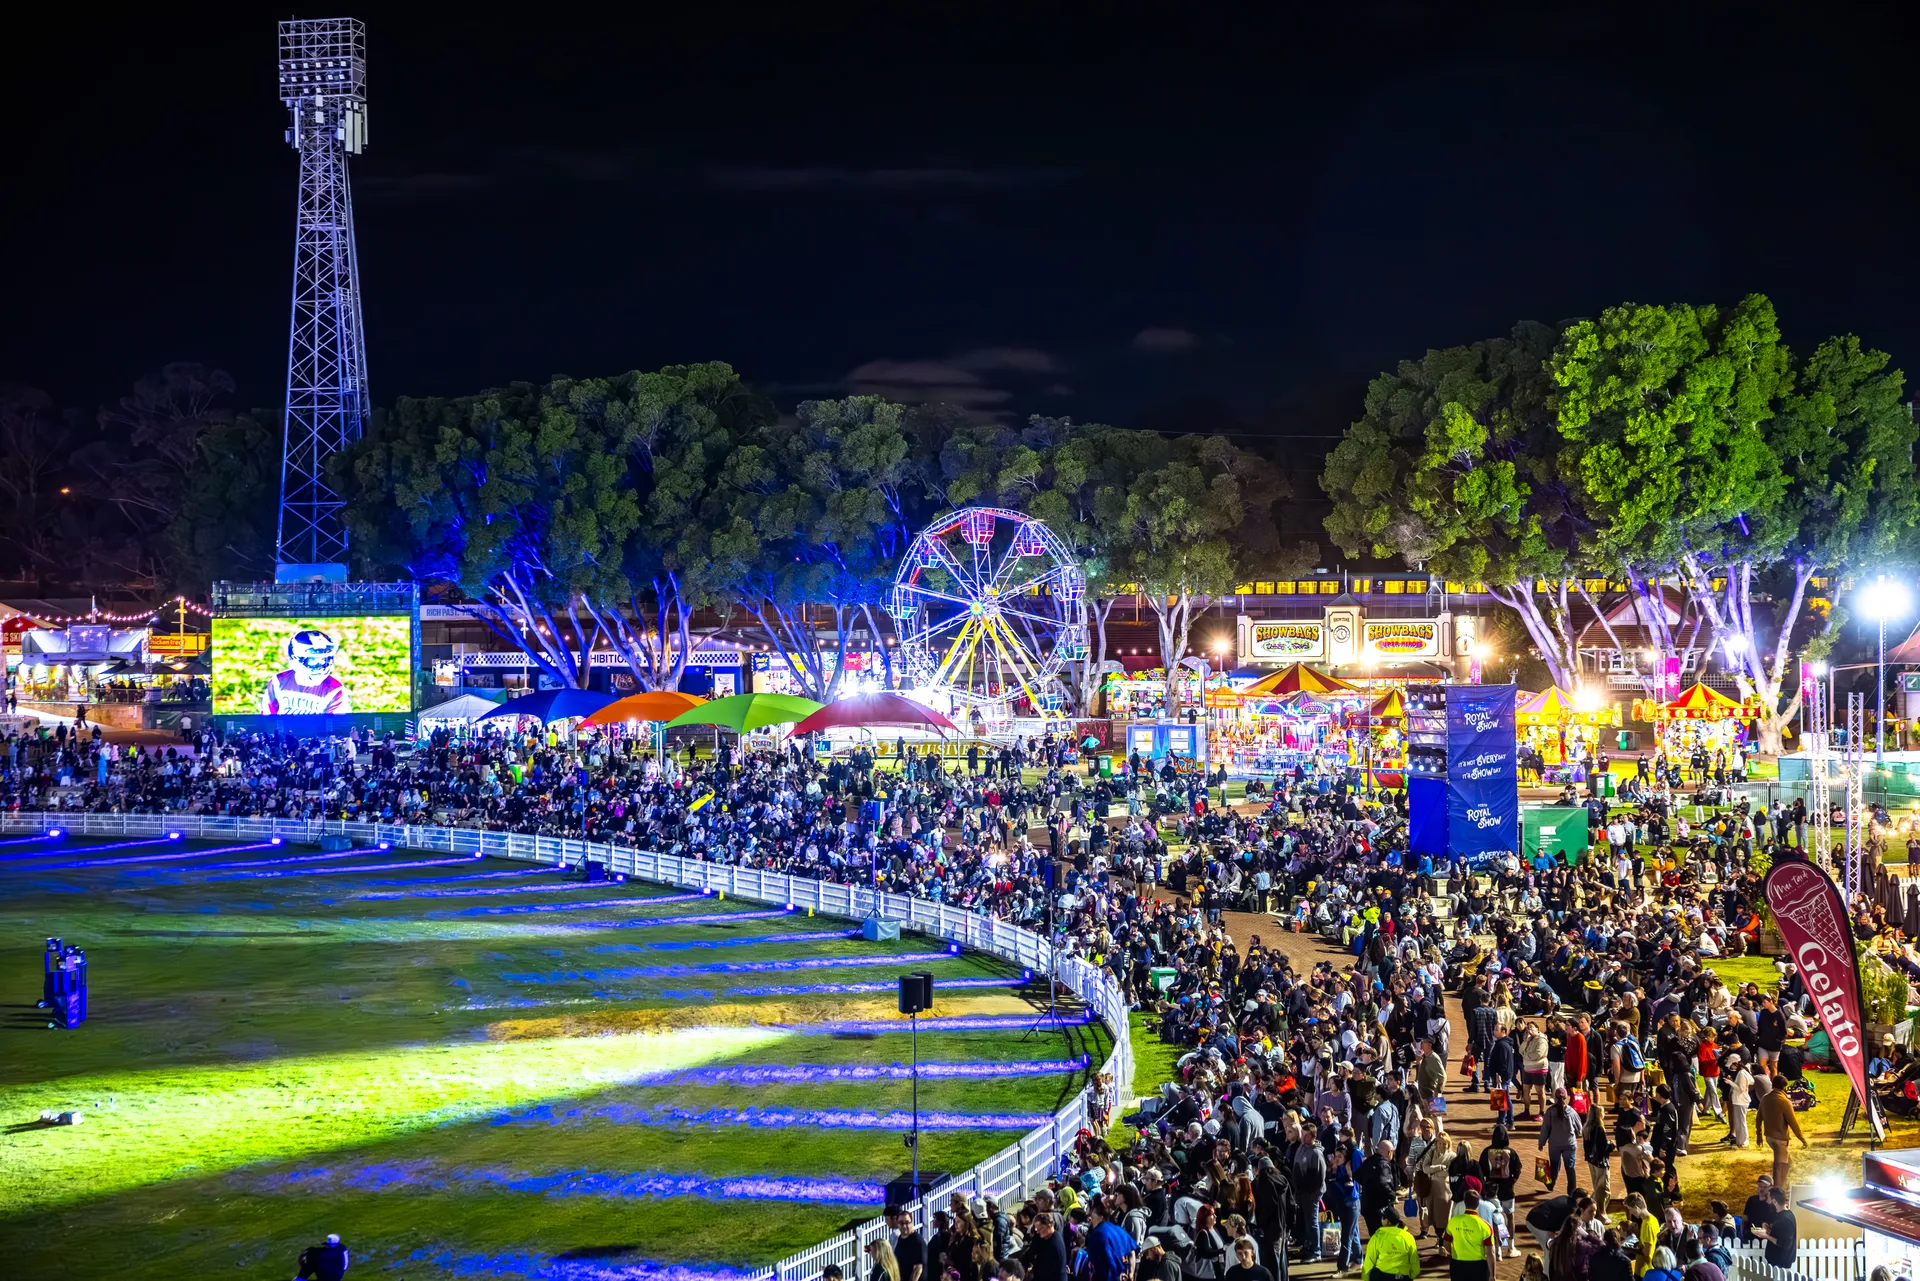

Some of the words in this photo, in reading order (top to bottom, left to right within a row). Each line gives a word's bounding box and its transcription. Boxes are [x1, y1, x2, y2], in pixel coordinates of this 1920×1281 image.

[427, 608, 441, 616] RICH
[1256, 626, 1319, 642] SHOWBAGS
[1367, 624, 1433, 641] SHOWBAGS
[577, 655, 628, 664] EHIBITIO
[1464, 711, 1490, 725] ROYAL
[1476, 719, 1499, 732] SHOW
[885, 742, 970, 757] EXCLUSIVE
[1476, 754, 1498, 766] EVERY
[1471, 767, 1493, 780] SHOW
[1466, 808, 1491, 821] ROYAL
[1477, 816, 1502, 829] SHOW
[1798, 942, 1860, 1057] Gelato
